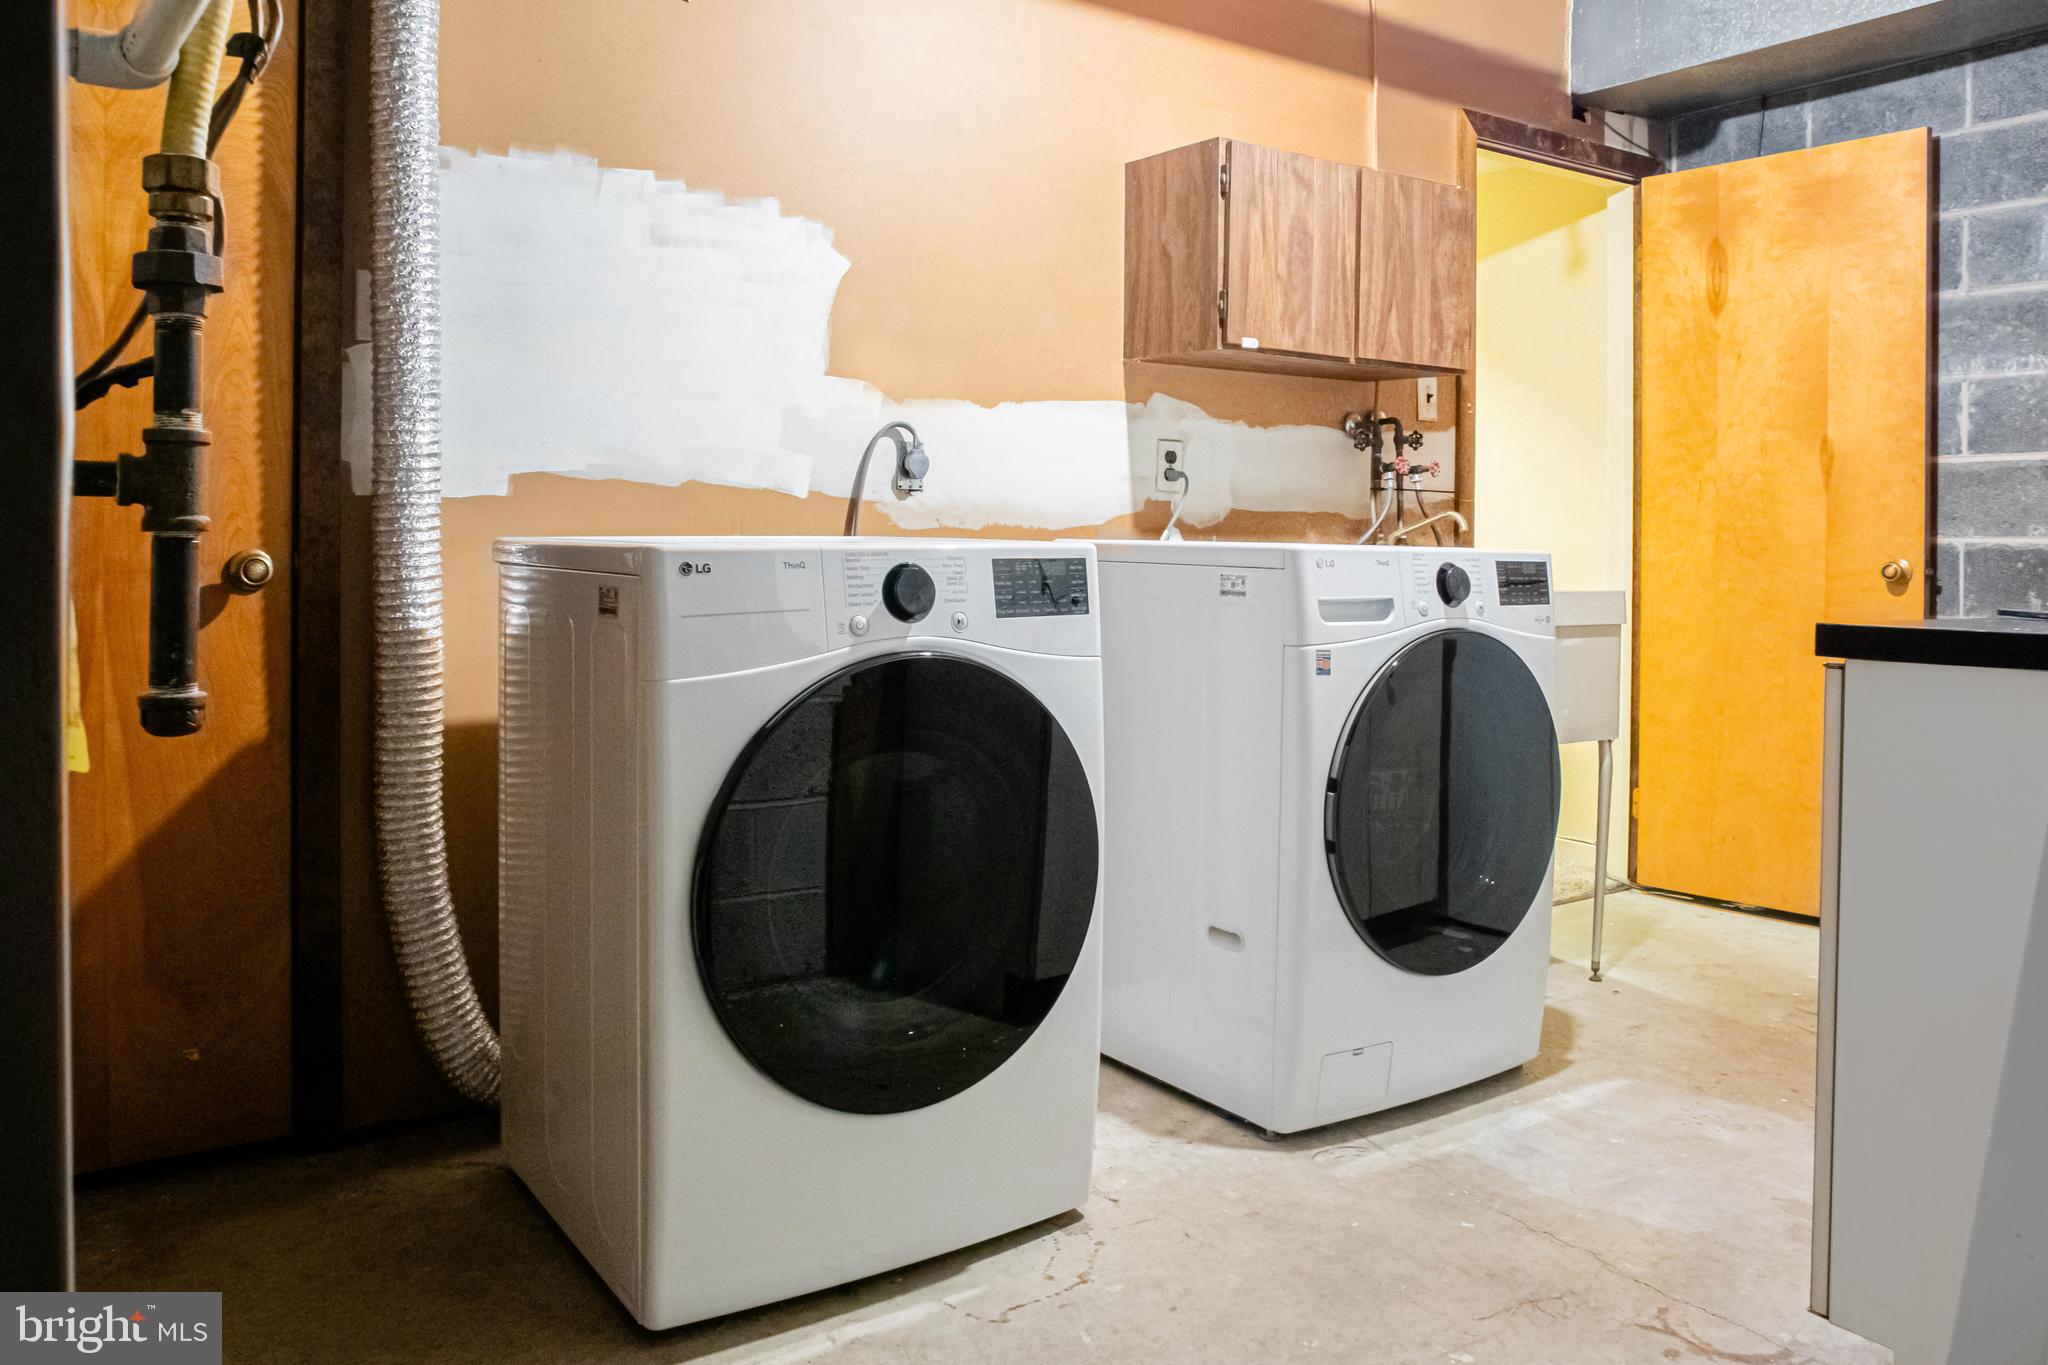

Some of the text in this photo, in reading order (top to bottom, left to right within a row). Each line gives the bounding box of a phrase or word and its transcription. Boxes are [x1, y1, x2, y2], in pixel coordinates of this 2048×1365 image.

[695, 563, 712, 574] LG
[783, 560, 806, 570] ThinQ
[1325, 559, 1336, 568] LG
